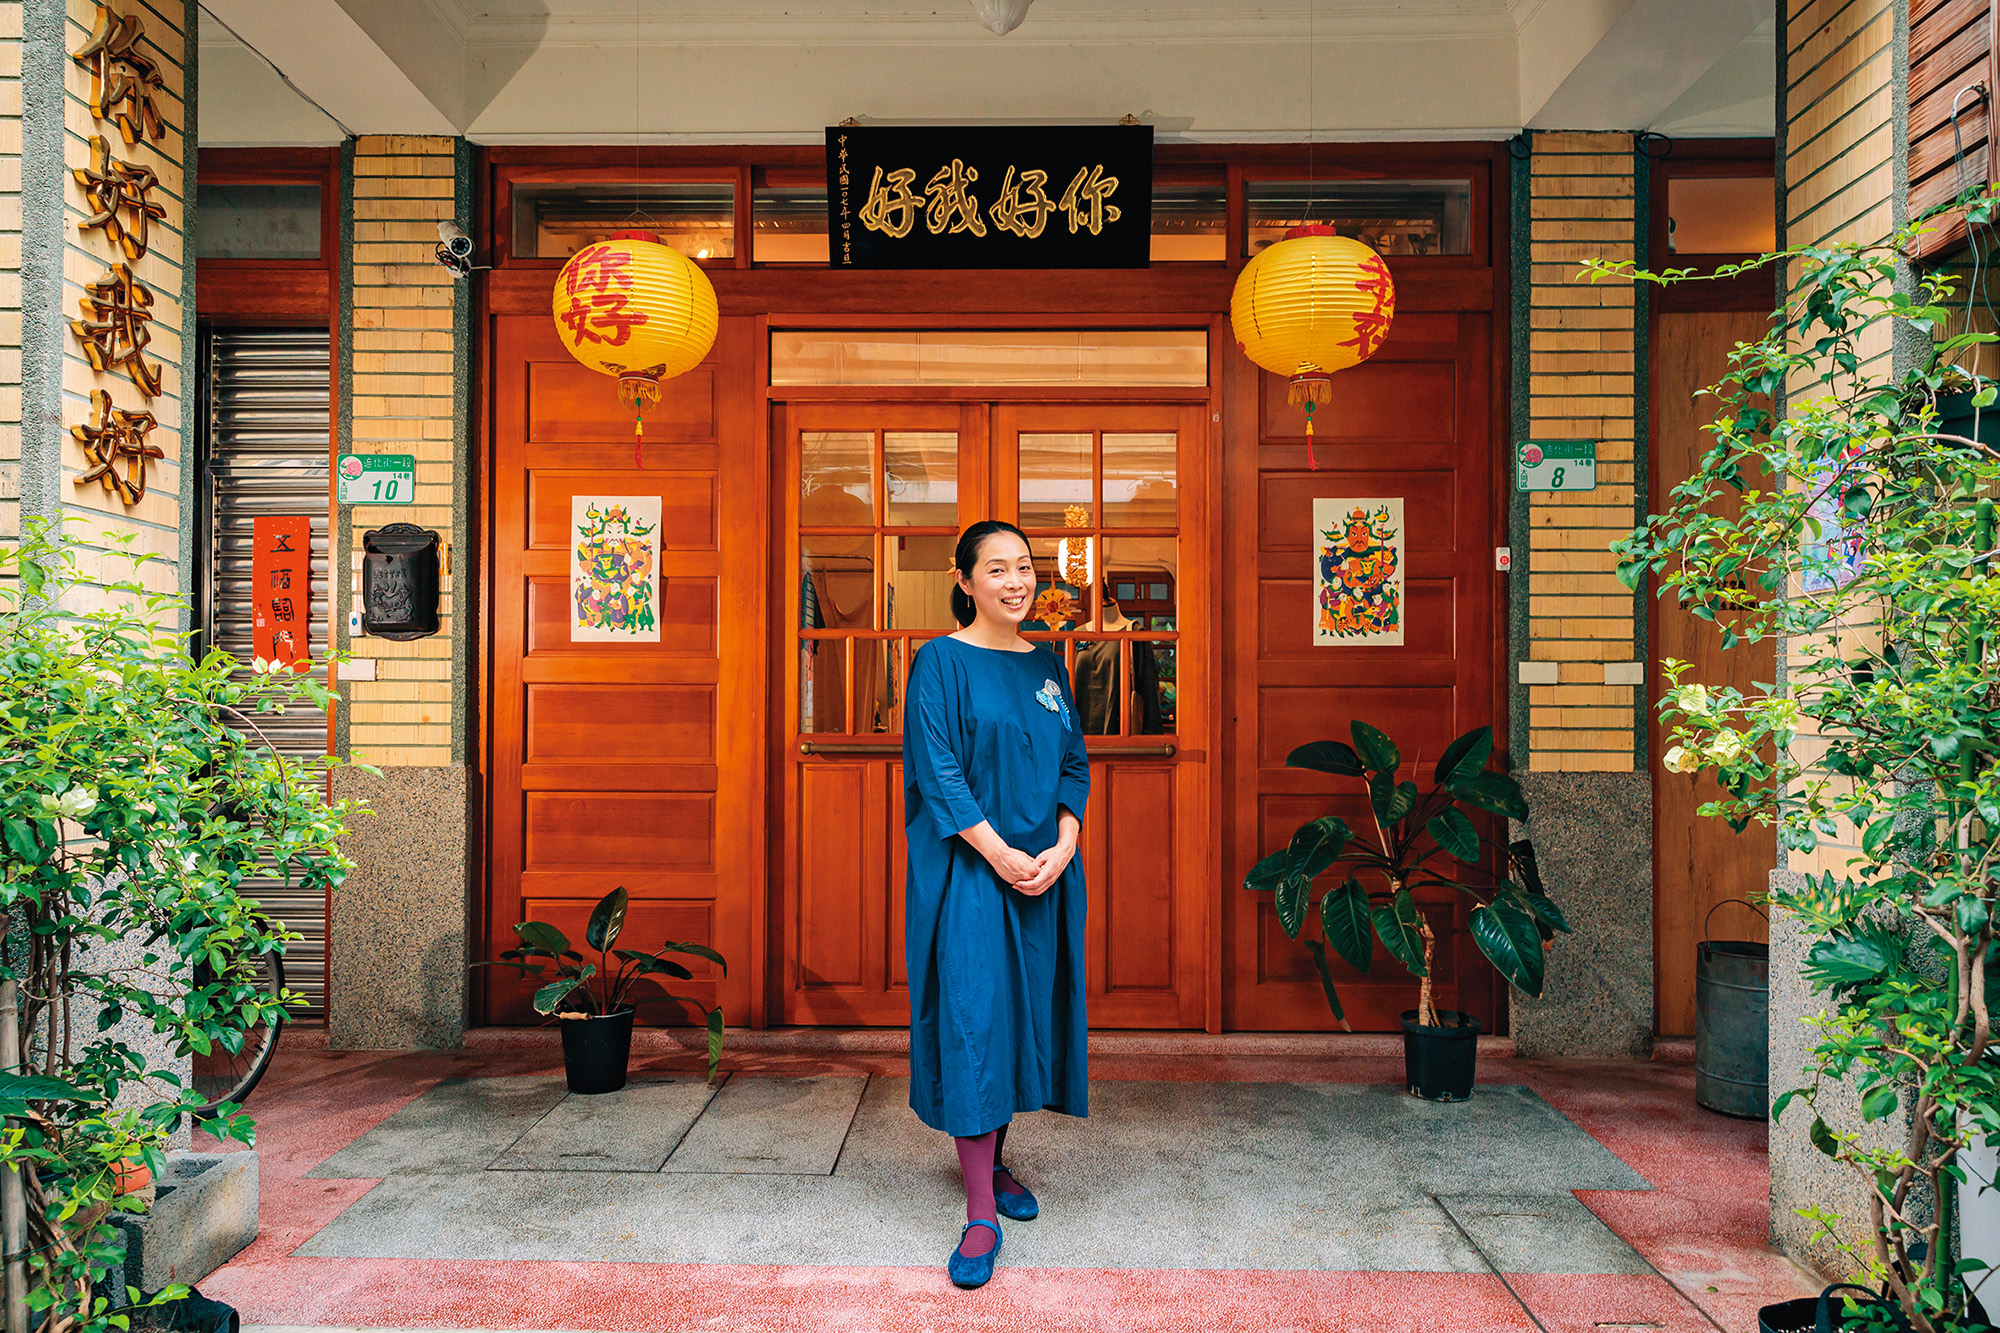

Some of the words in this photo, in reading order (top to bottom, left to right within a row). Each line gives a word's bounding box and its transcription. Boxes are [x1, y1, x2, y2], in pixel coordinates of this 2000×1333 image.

[70, 6, 166, 505] 你好我好
[1551, 467, 1565, 488] 8
[372, 480, 399, 501] 10
